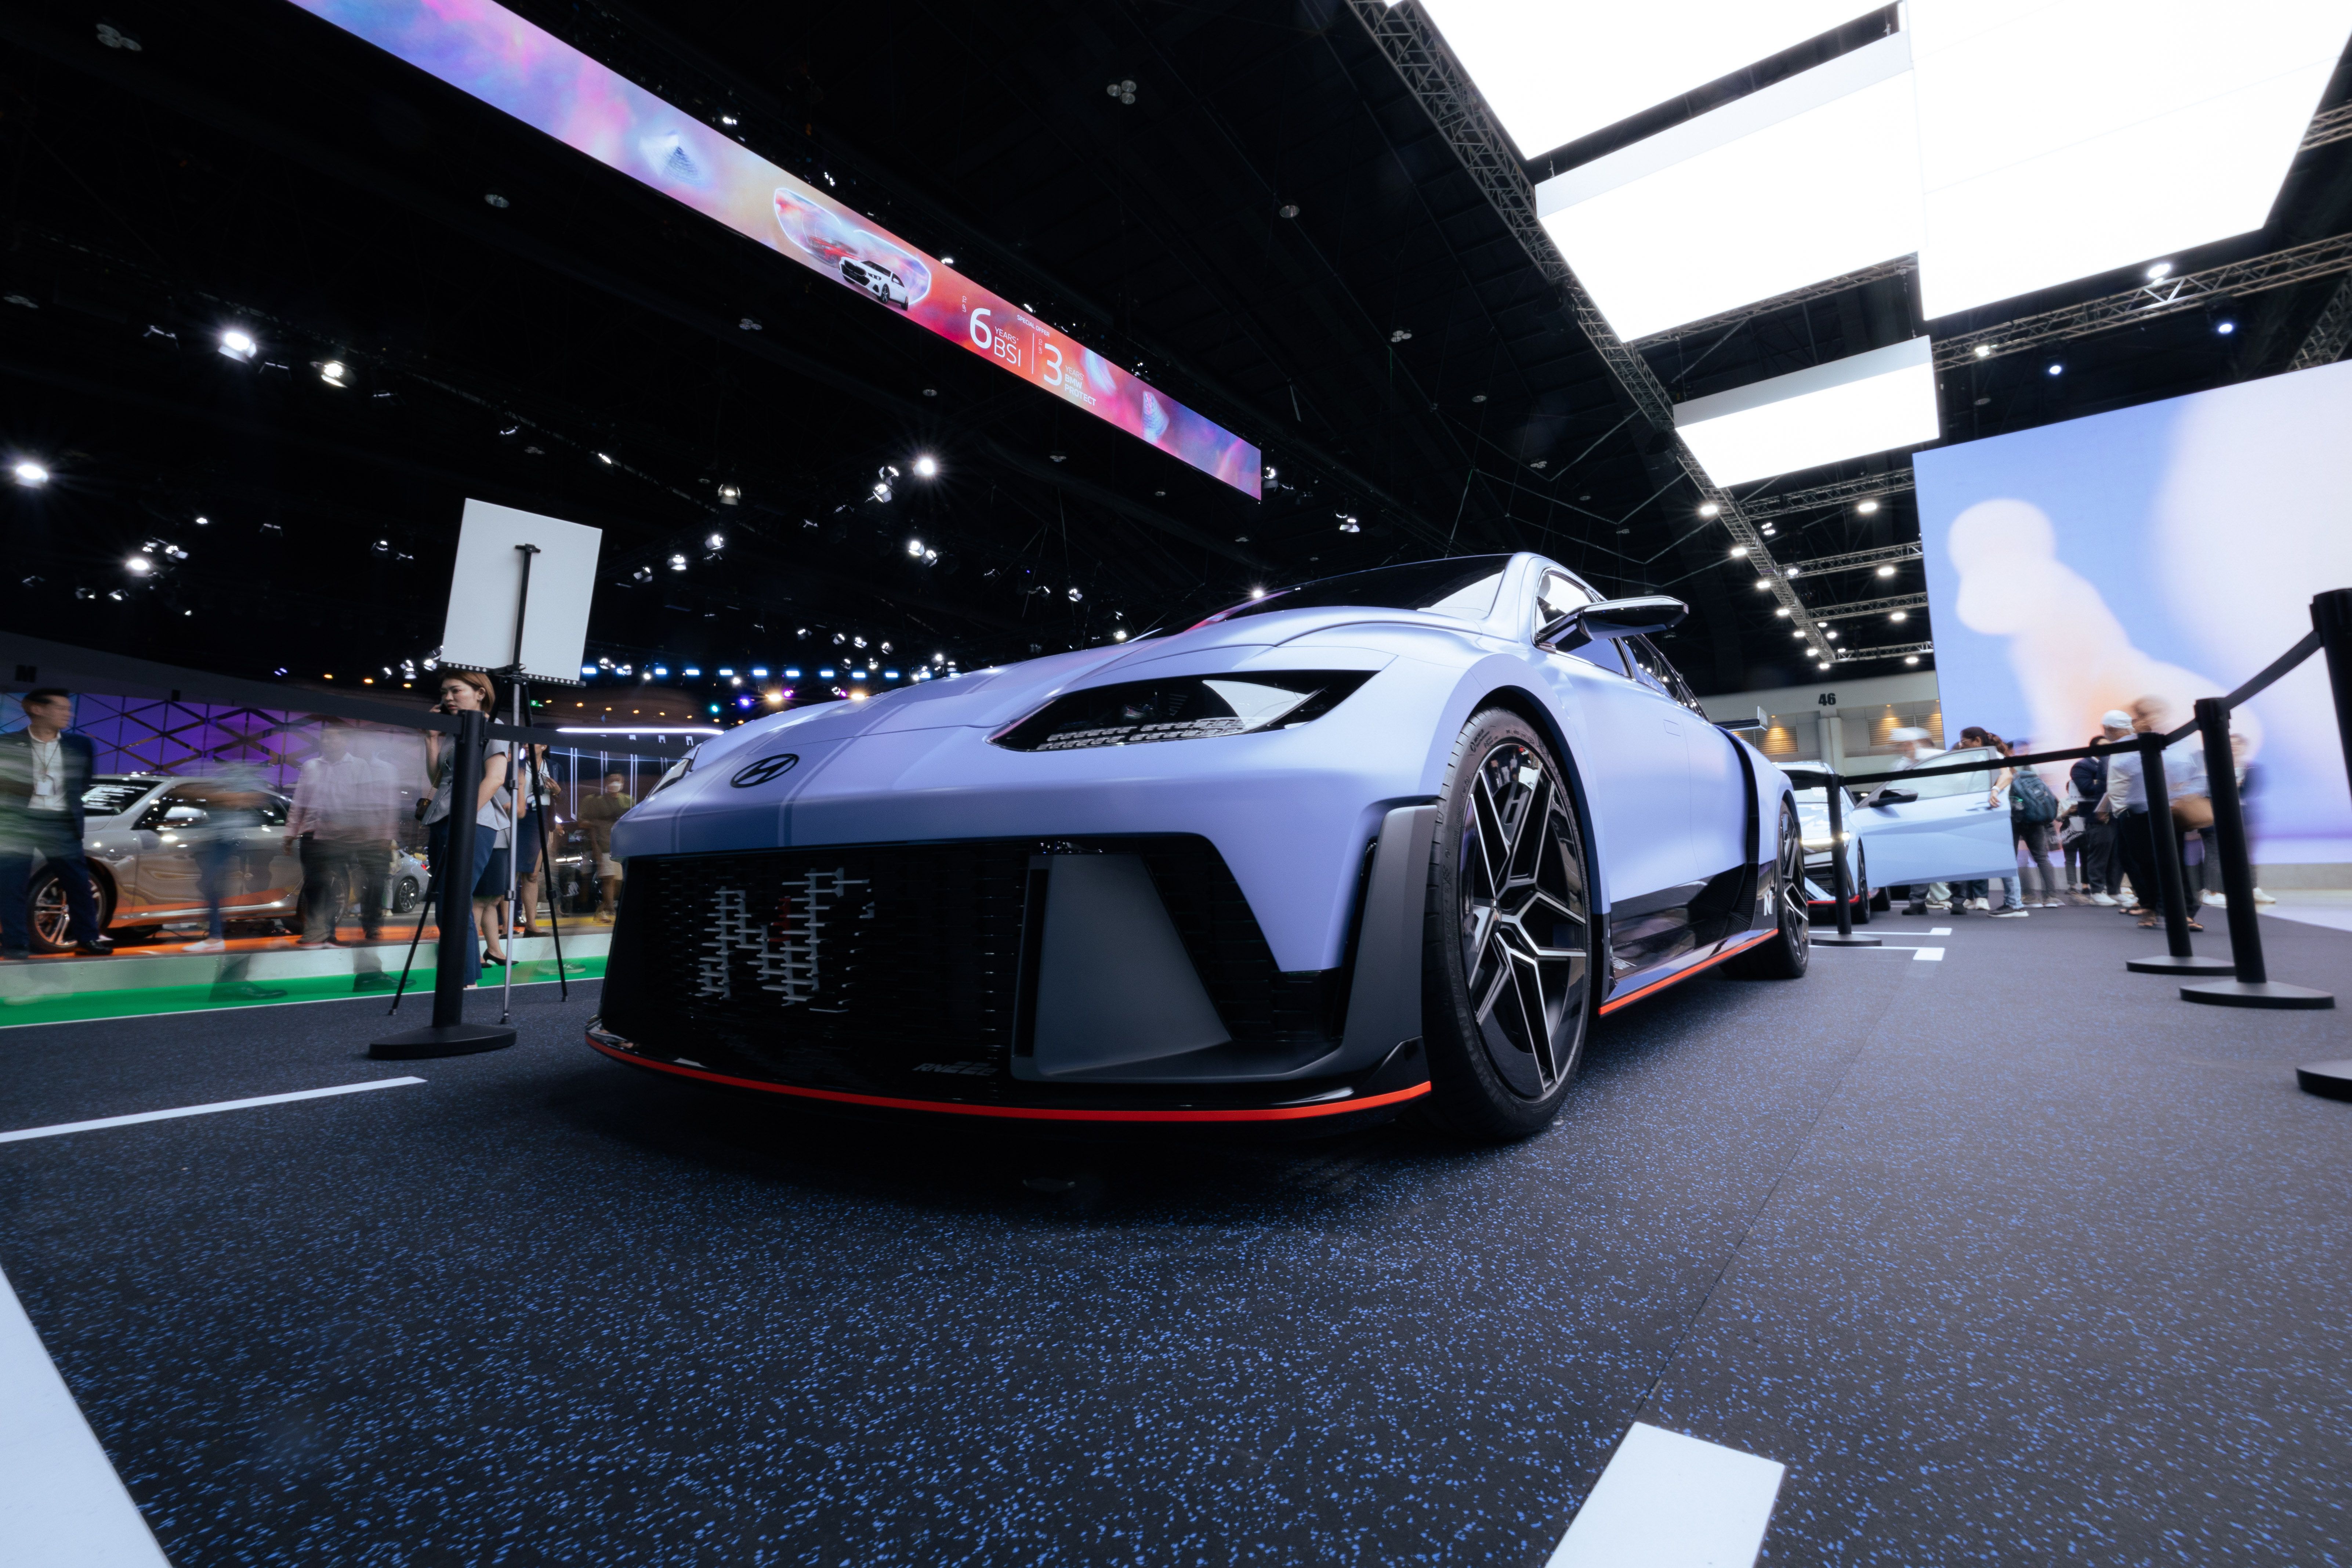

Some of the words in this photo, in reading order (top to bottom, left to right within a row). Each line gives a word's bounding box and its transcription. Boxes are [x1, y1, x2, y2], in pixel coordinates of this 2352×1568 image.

[962, 304, 967, 312] UP
[970, 308, 992, 349] 6
[1017, 315, 1035, 329] SPECIAL
[1036, 325, 1050, 337] OFFER
[994, 336, 1021, 367] BSI
[1044, 343, 1062, 385] 3
[1065, 373, 1082, 389] BMW
[1065, 383, 1097, 406] PROTECT
[1818, 693, 1836, 706] 46
[1763, 890, 1773, 916] N
